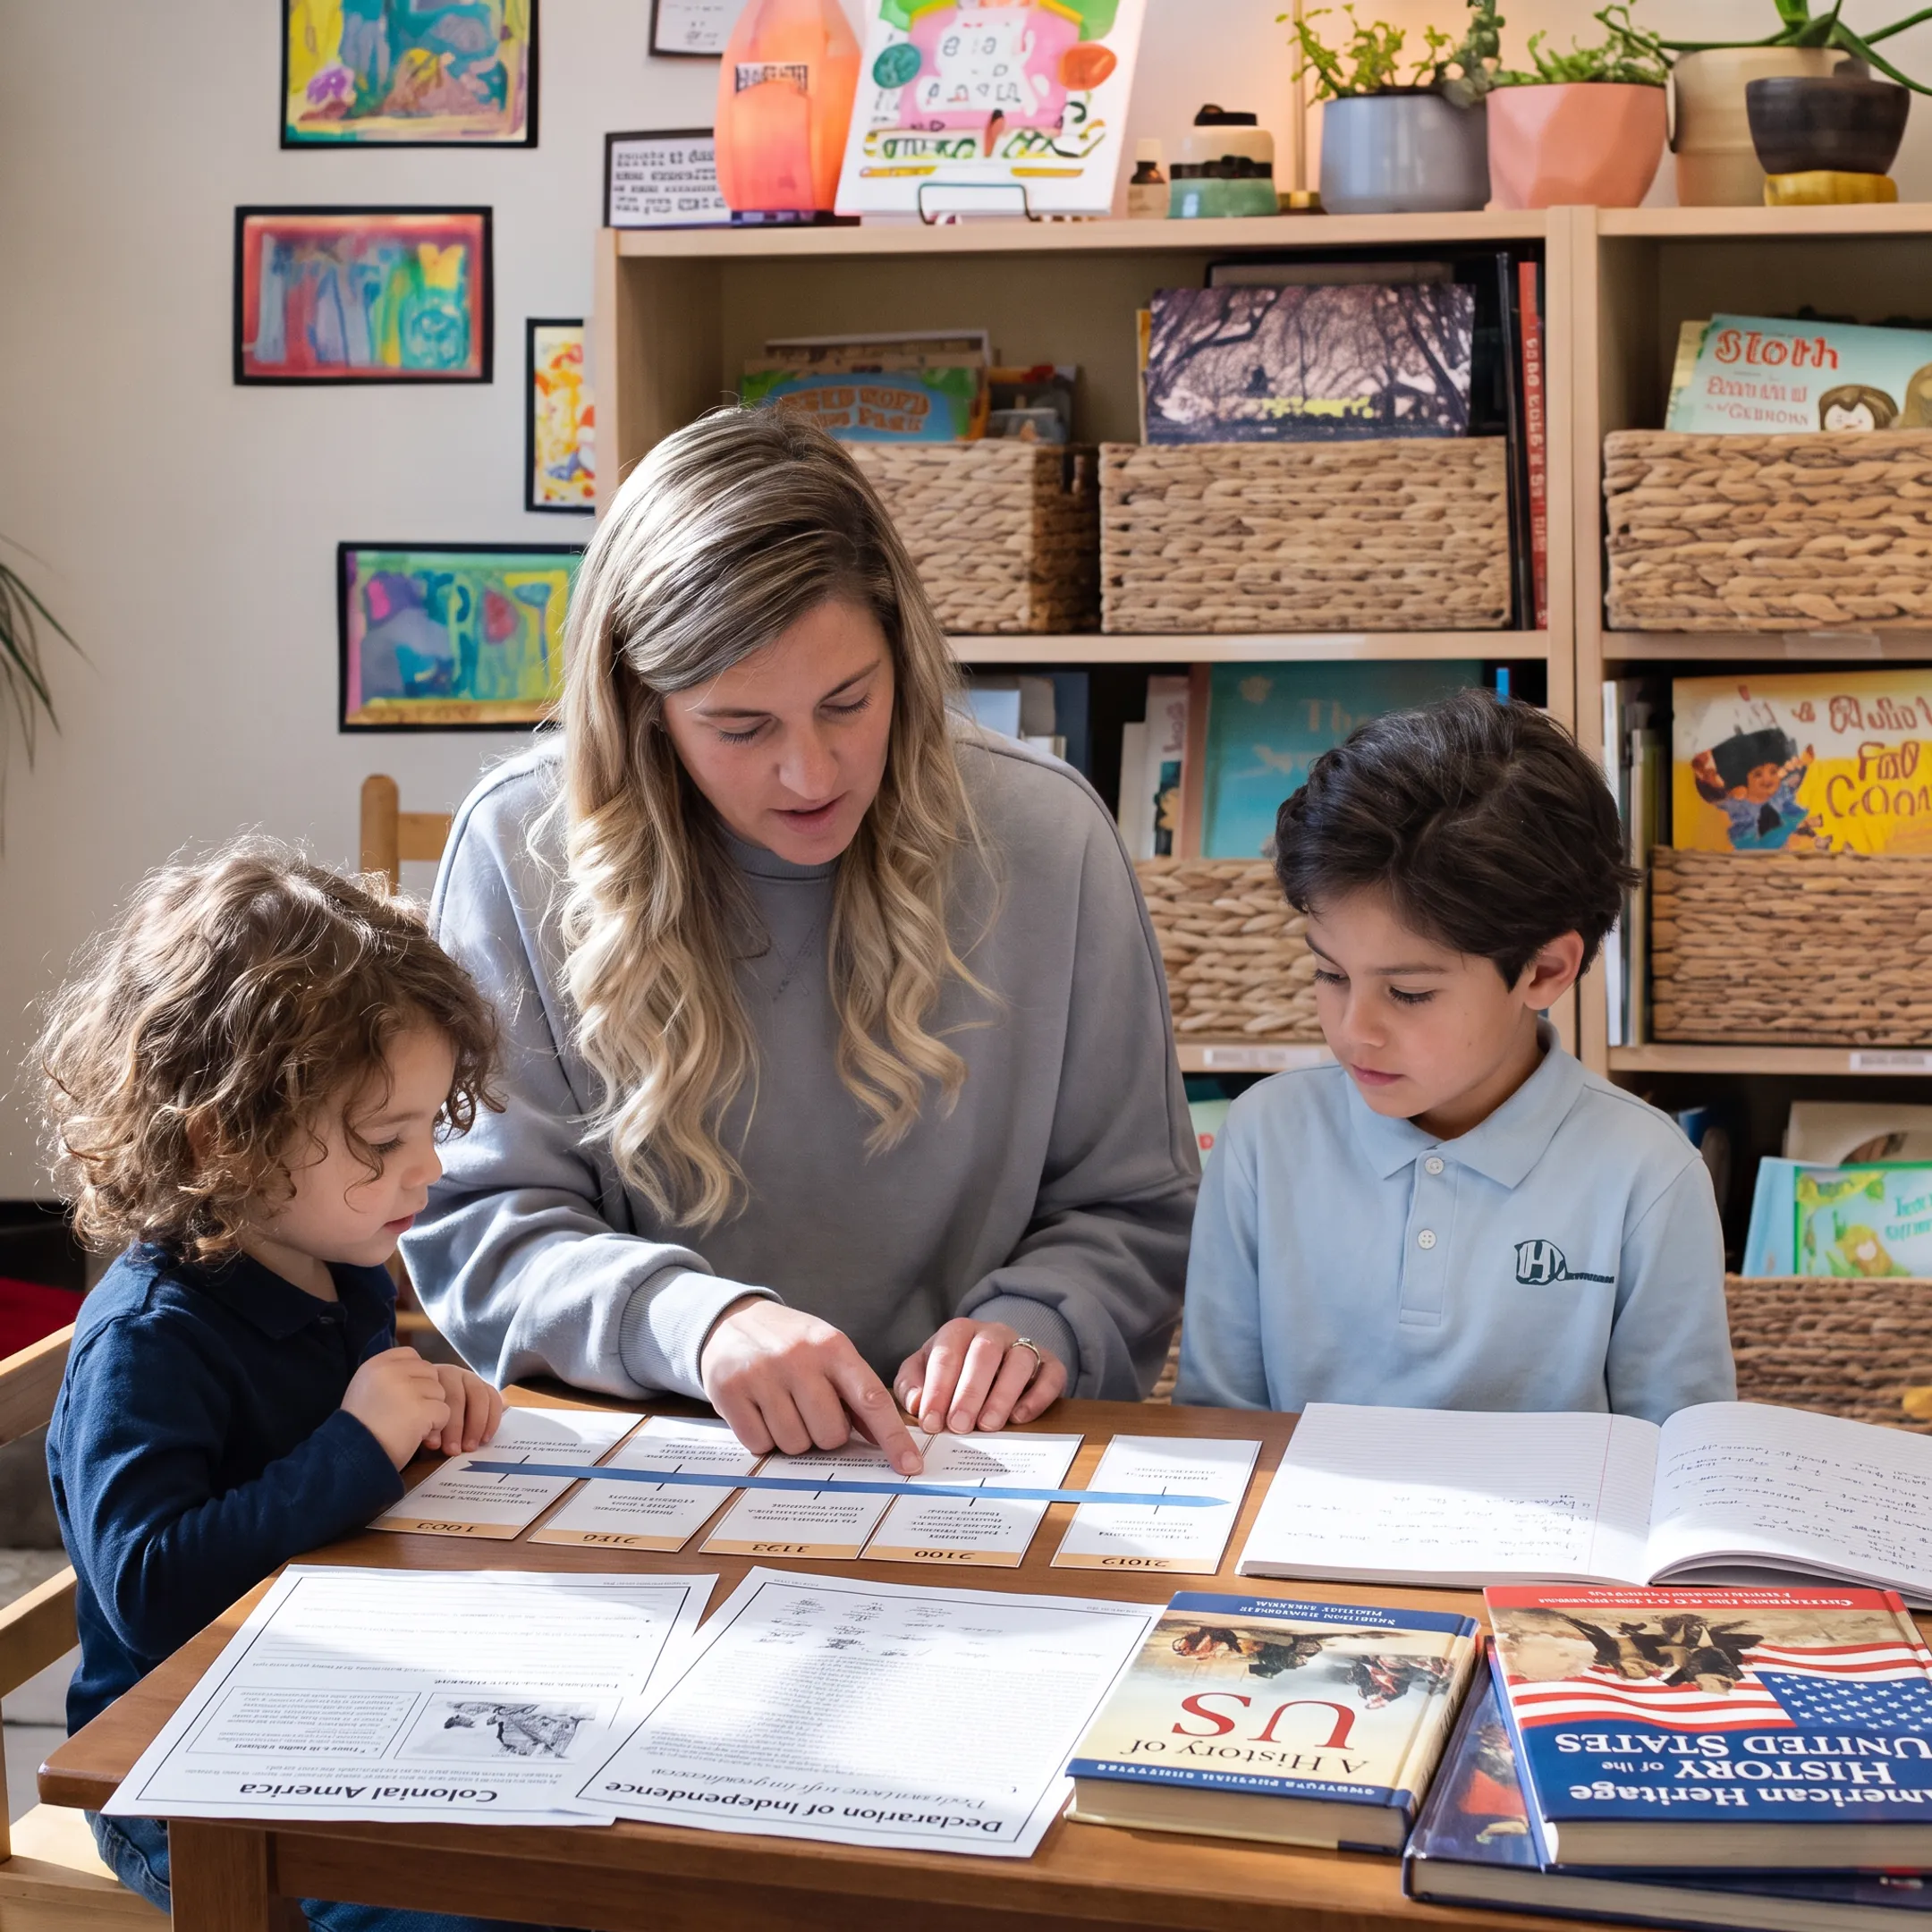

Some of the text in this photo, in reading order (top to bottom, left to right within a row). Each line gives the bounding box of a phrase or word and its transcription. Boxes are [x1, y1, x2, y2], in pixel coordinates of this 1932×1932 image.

[1172, 1692, 1355, 1750] US
[1119, 1739, 1368, 1775] A History of
[1555, 1733, 1932, 1758] UNITED STATES
[1640, 1761, 1665, 1772] of
[1674, 1760, 1896, 1784] HISTORY
[238, 1784, 498, 1802] Colonial America
[604, 1780, 799, 1815] Independence
[1568, 1781, 1749, 1806] Heritage
[802, 1803, 835, 1817] of
